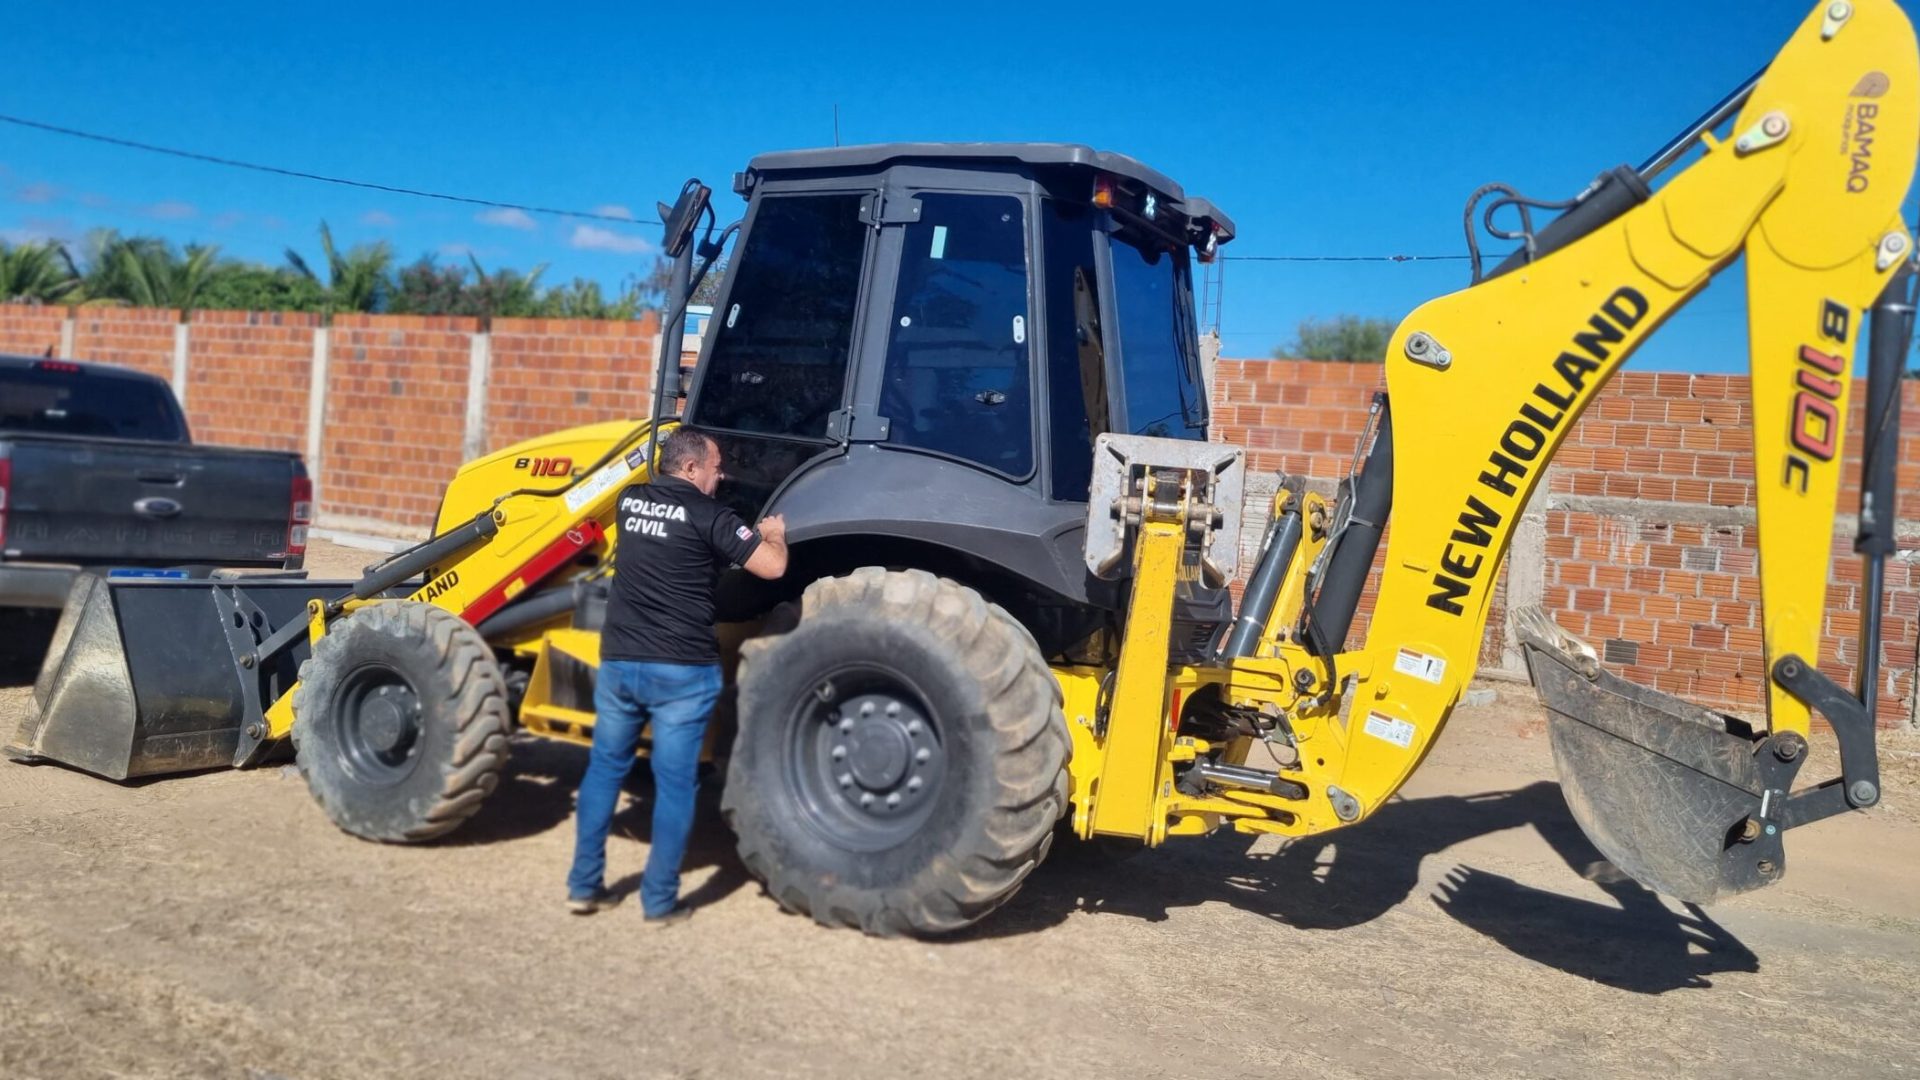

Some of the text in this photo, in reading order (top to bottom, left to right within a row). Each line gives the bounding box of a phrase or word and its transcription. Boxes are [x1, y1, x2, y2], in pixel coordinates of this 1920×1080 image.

[1846, 103, 1878, 193] BAMAQ
[1426, 286, 1649, 616] NEW HOLLAND
[625, 516, 668, 538] CIVIL
